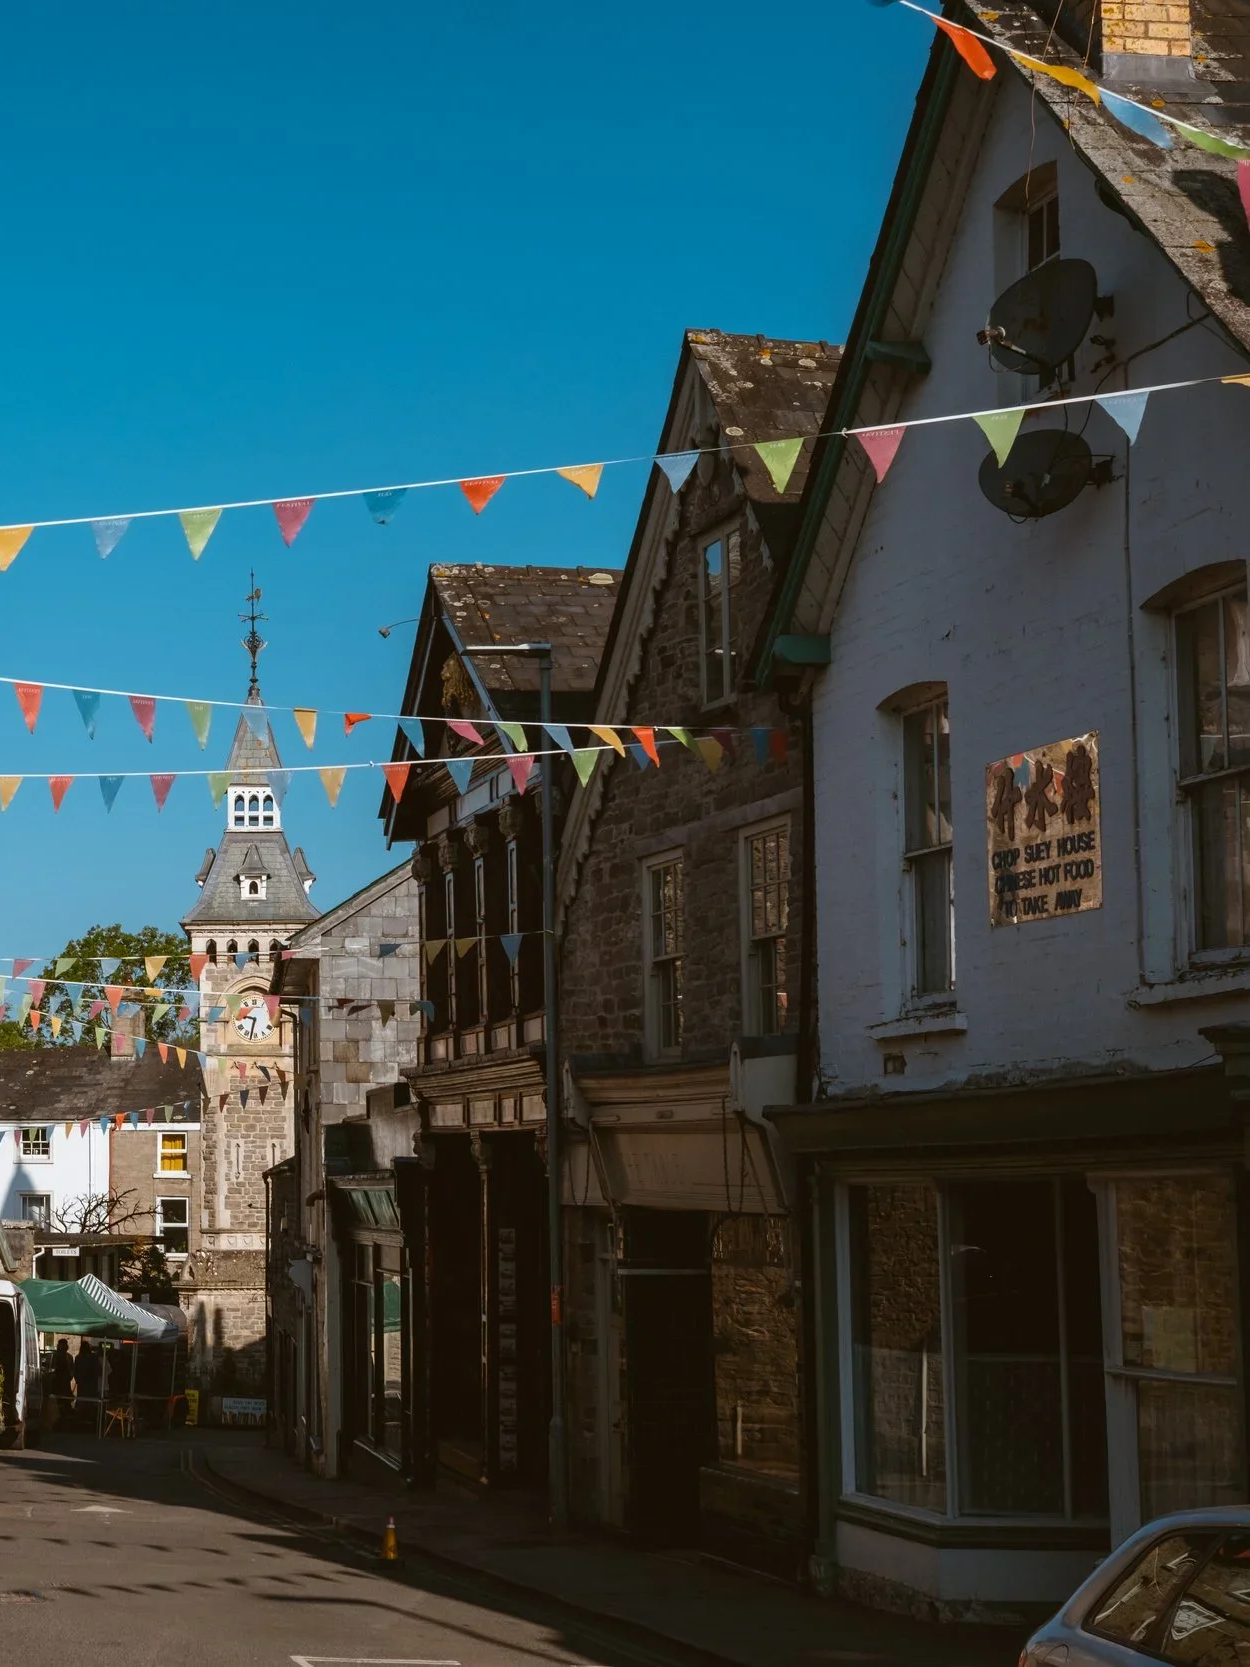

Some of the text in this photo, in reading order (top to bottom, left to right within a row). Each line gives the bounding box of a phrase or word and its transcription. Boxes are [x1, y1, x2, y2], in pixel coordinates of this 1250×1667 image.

[992, 831, 1095, 870] CHOP SUEY HOUSE
[1039, 864, 1062, 886] HOT
[1064, 858, 1094, 881] FOOD
[1020, 894, 1048, 916] TAKE
[1054, 888, 1083, 911] AWAY
